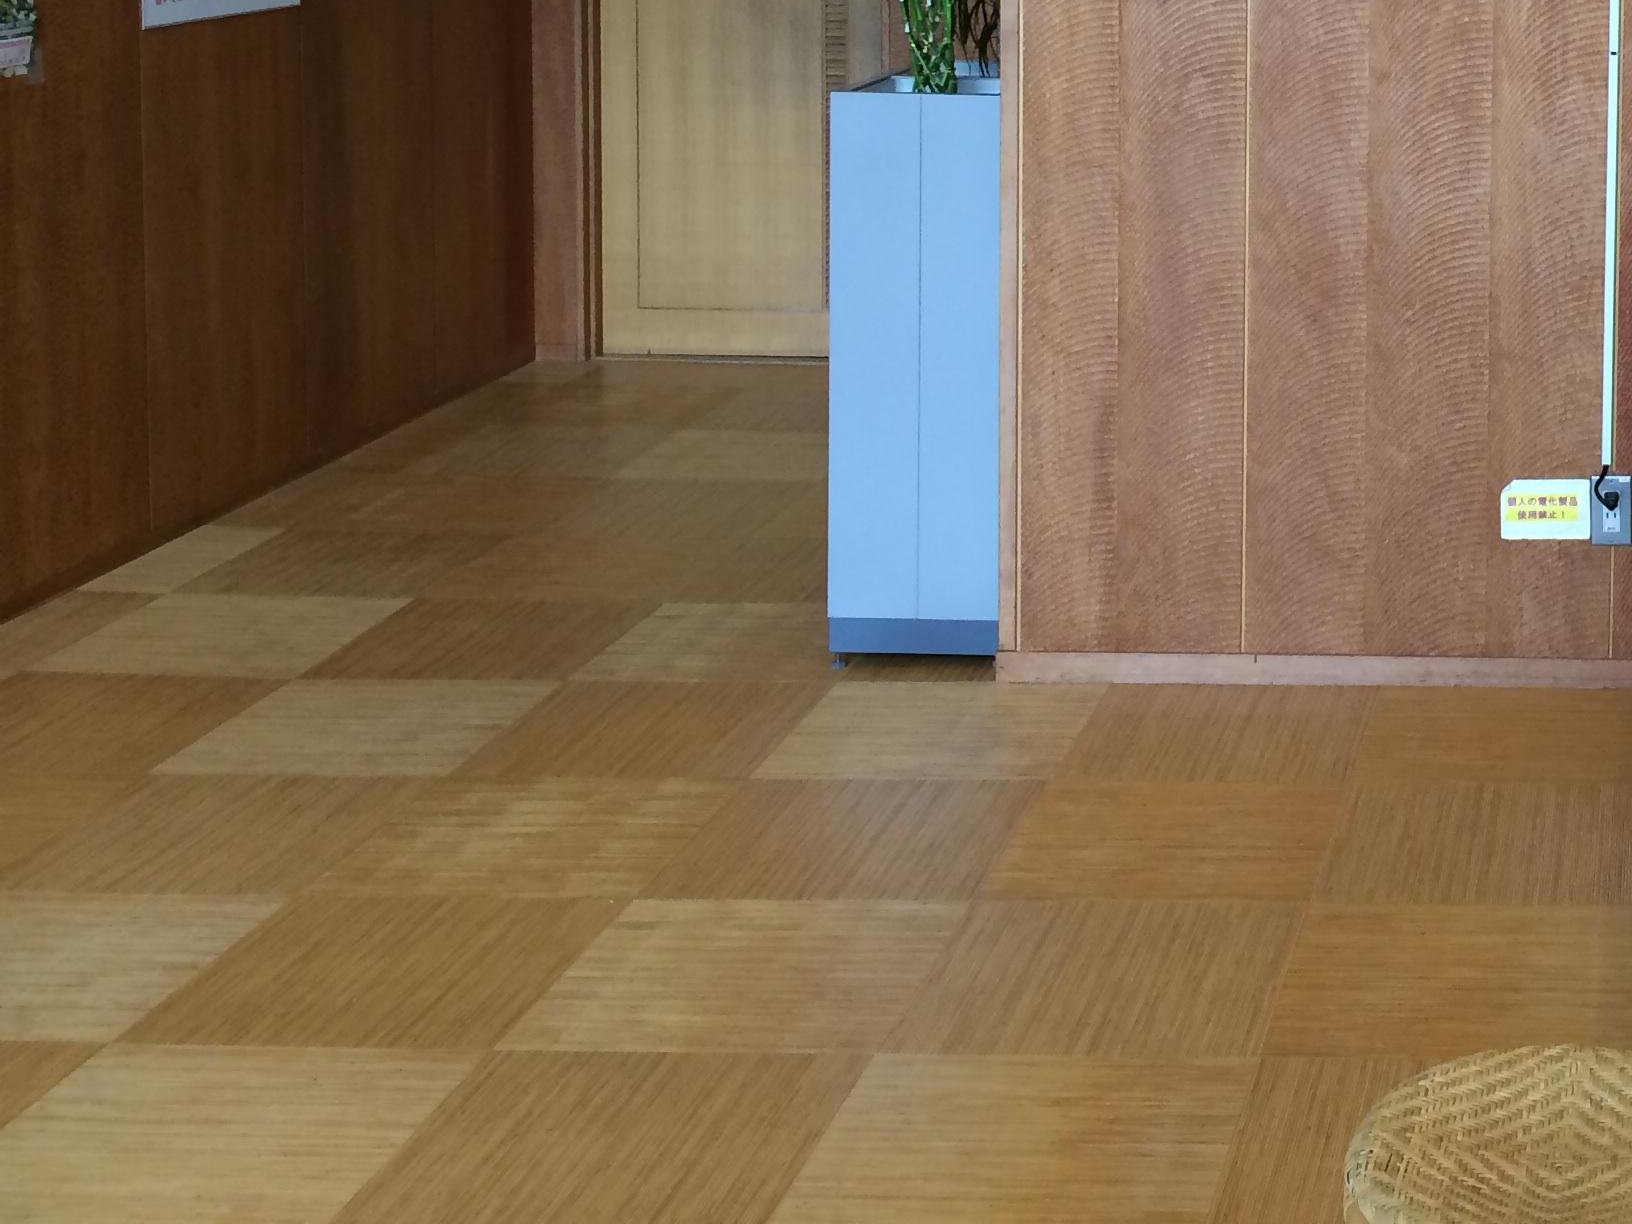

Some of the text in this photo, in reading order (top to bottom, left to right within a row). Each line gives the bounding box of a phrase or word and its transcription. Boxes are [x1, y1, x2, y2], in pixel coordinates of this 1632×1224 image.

[1507, 496, 1578, 507] 個人の電化製品
